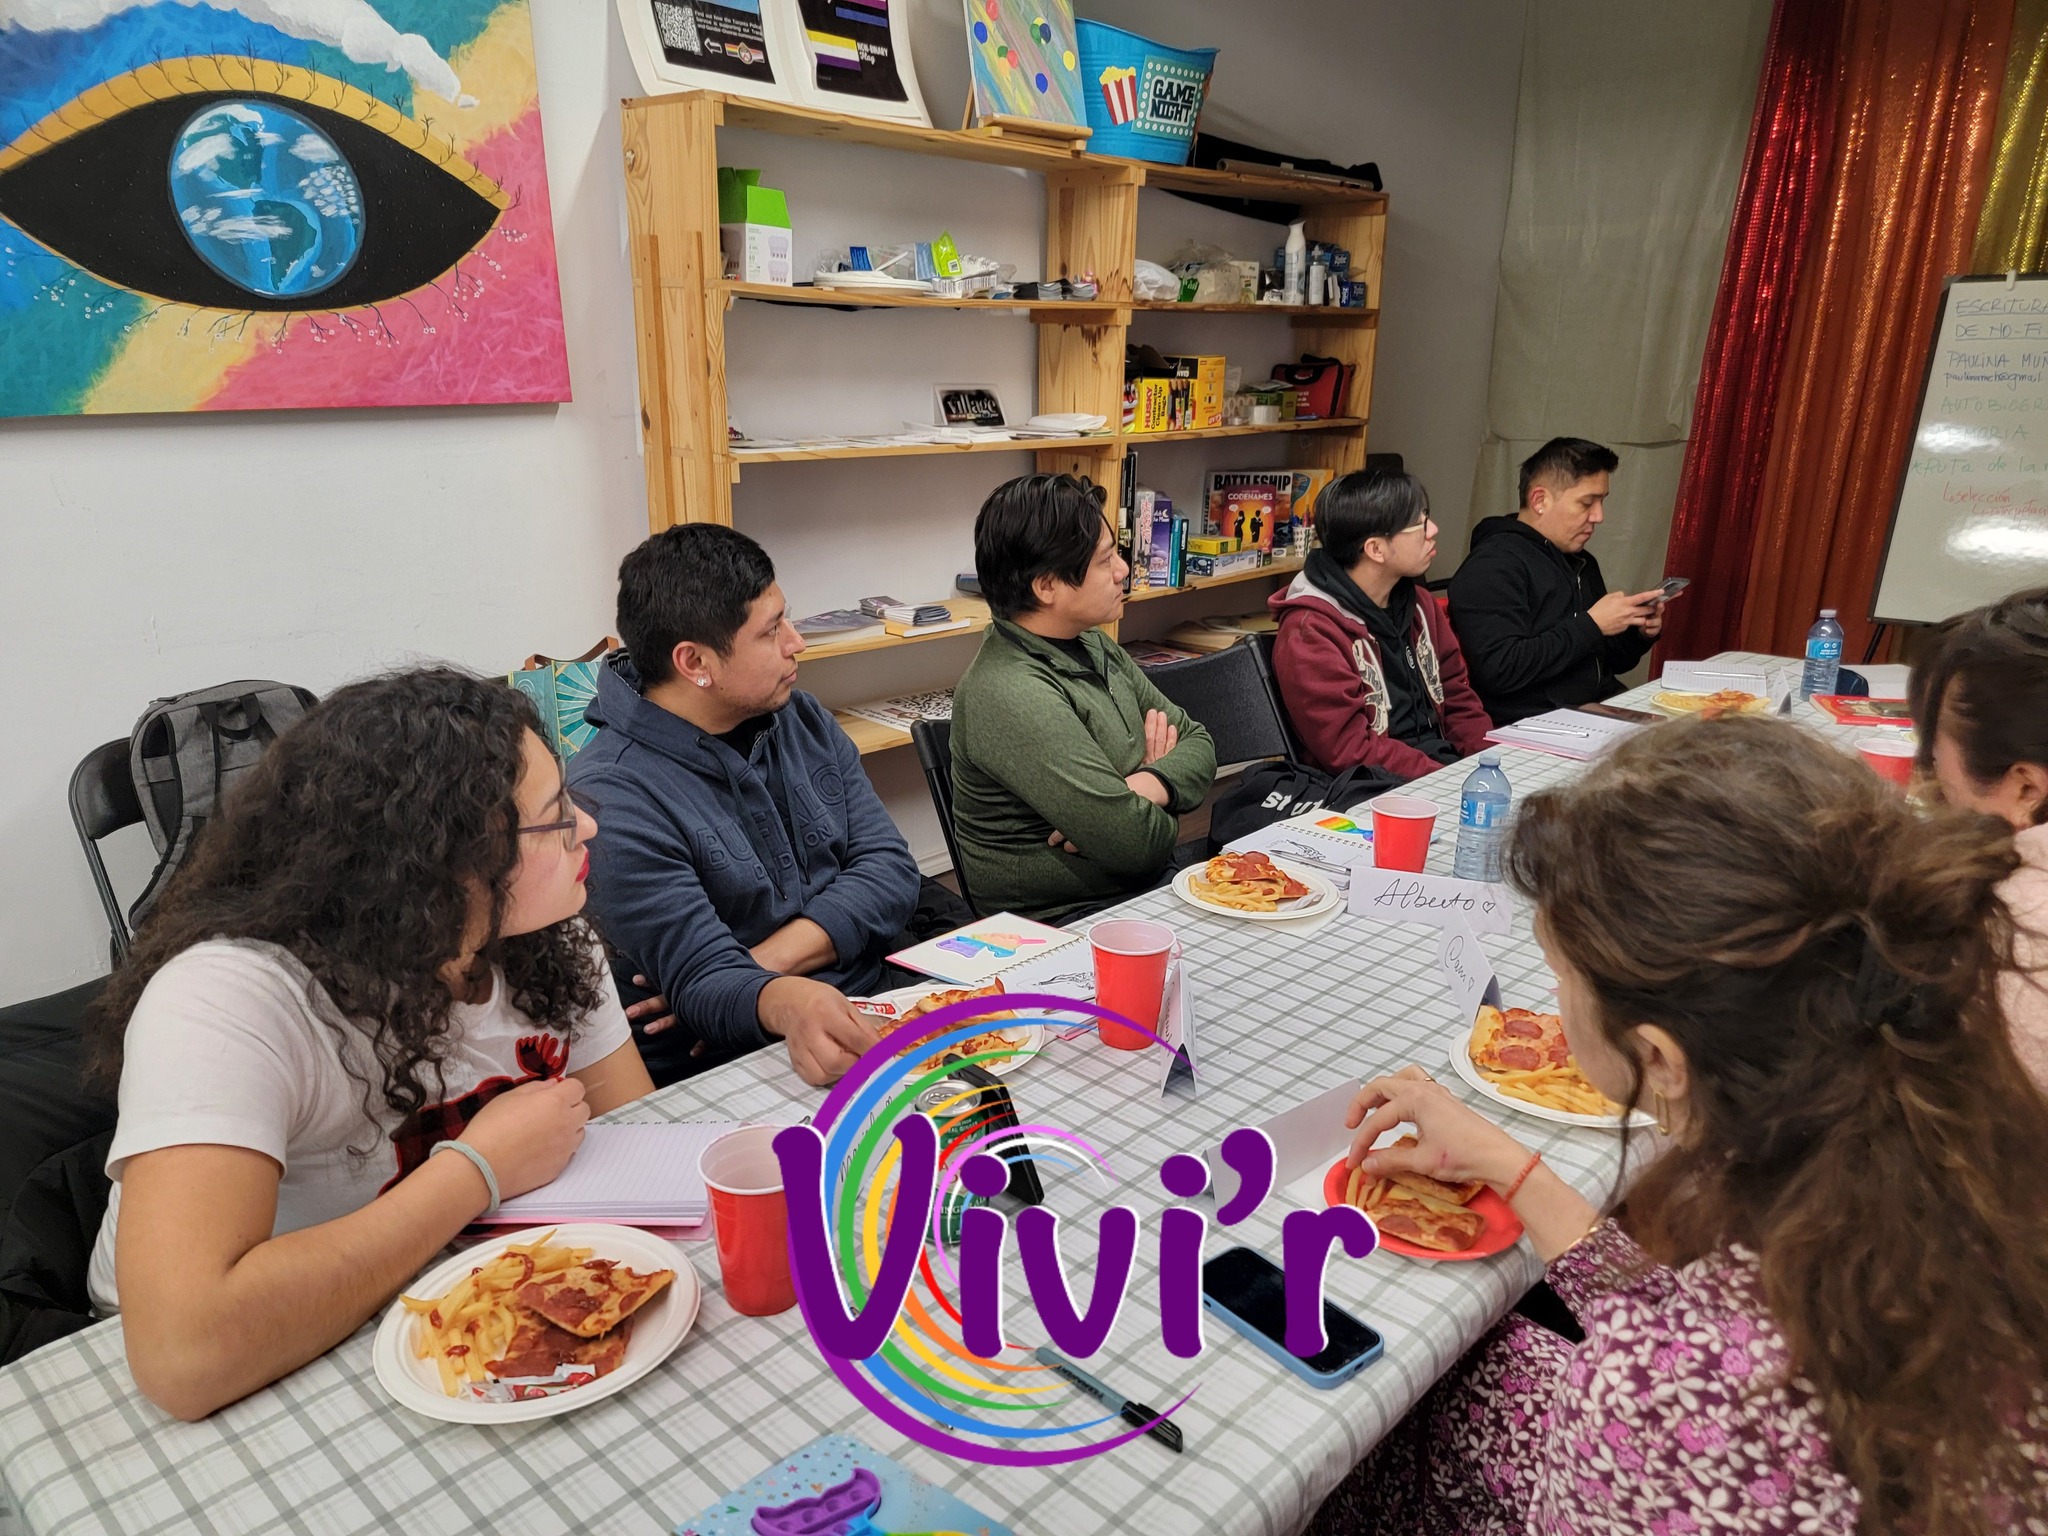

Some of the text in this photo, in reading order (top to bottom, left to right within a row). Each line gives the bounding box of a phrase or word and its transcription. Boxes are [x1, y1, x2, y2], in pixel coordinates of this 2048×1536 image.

[1153, 79, 1196, 103] GAME
[1150, 99, 1192, 122] NIGHT
[1955, 324, 1978, 337] DE
[947, 394, 997, 418] village
[1144, 386, 1153, 429] HUSKY
[1151, 384, 1159, 430] Contractor
[1988, 456, 2007, 473] de
[2018, 456, 2036, 473] la
[1214, 474, 1291, 491] BATTLESHIP
[1228, 493, 1273, 501] CODENAMES
[1373, 878, 1475, 911] Alberto
